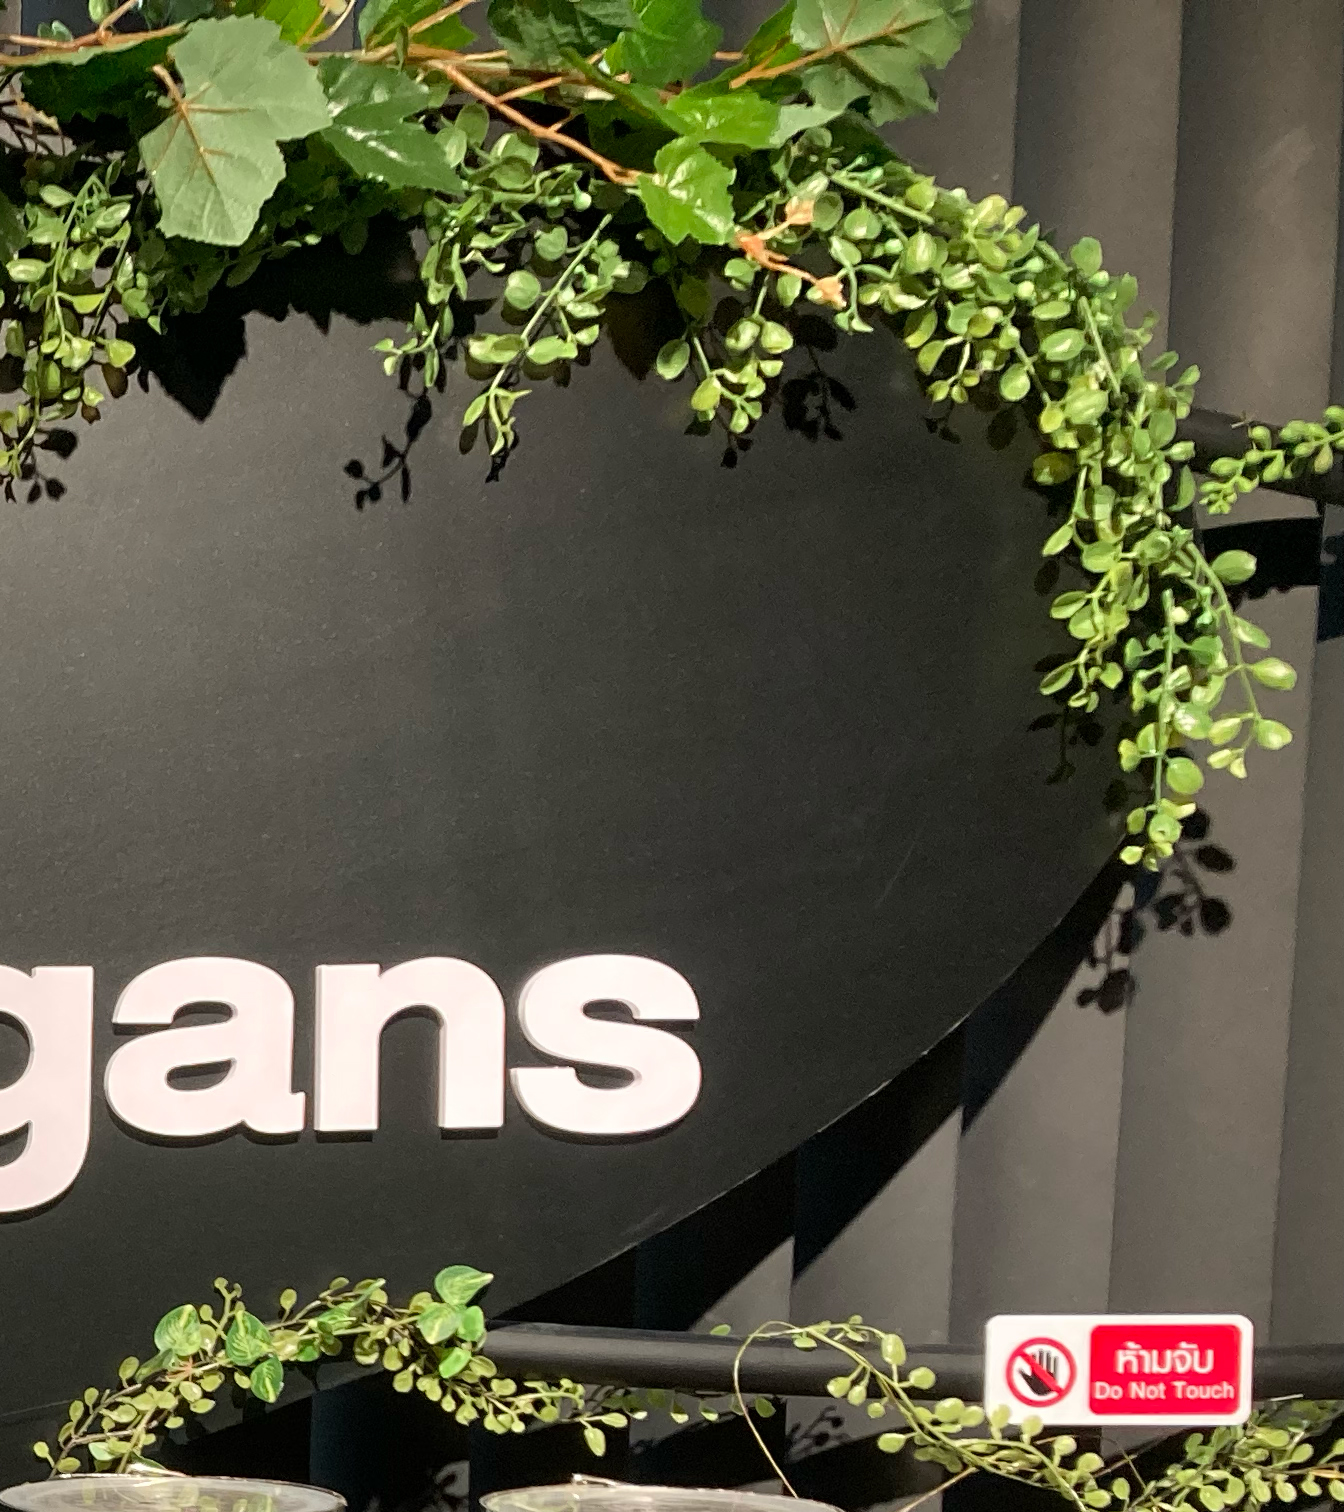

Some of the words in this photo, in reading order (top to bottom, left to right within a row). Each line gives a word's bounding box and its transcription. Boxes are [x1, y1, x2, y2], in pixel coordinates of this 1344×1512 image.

[1115, 1341, 1214, 1375] ห้ามจับ
[1094, 1382, 1123, 1400] Do
[1129, 1382, 1166, 1400] Not
[1172, 1381, 1235, 1400] Touch
